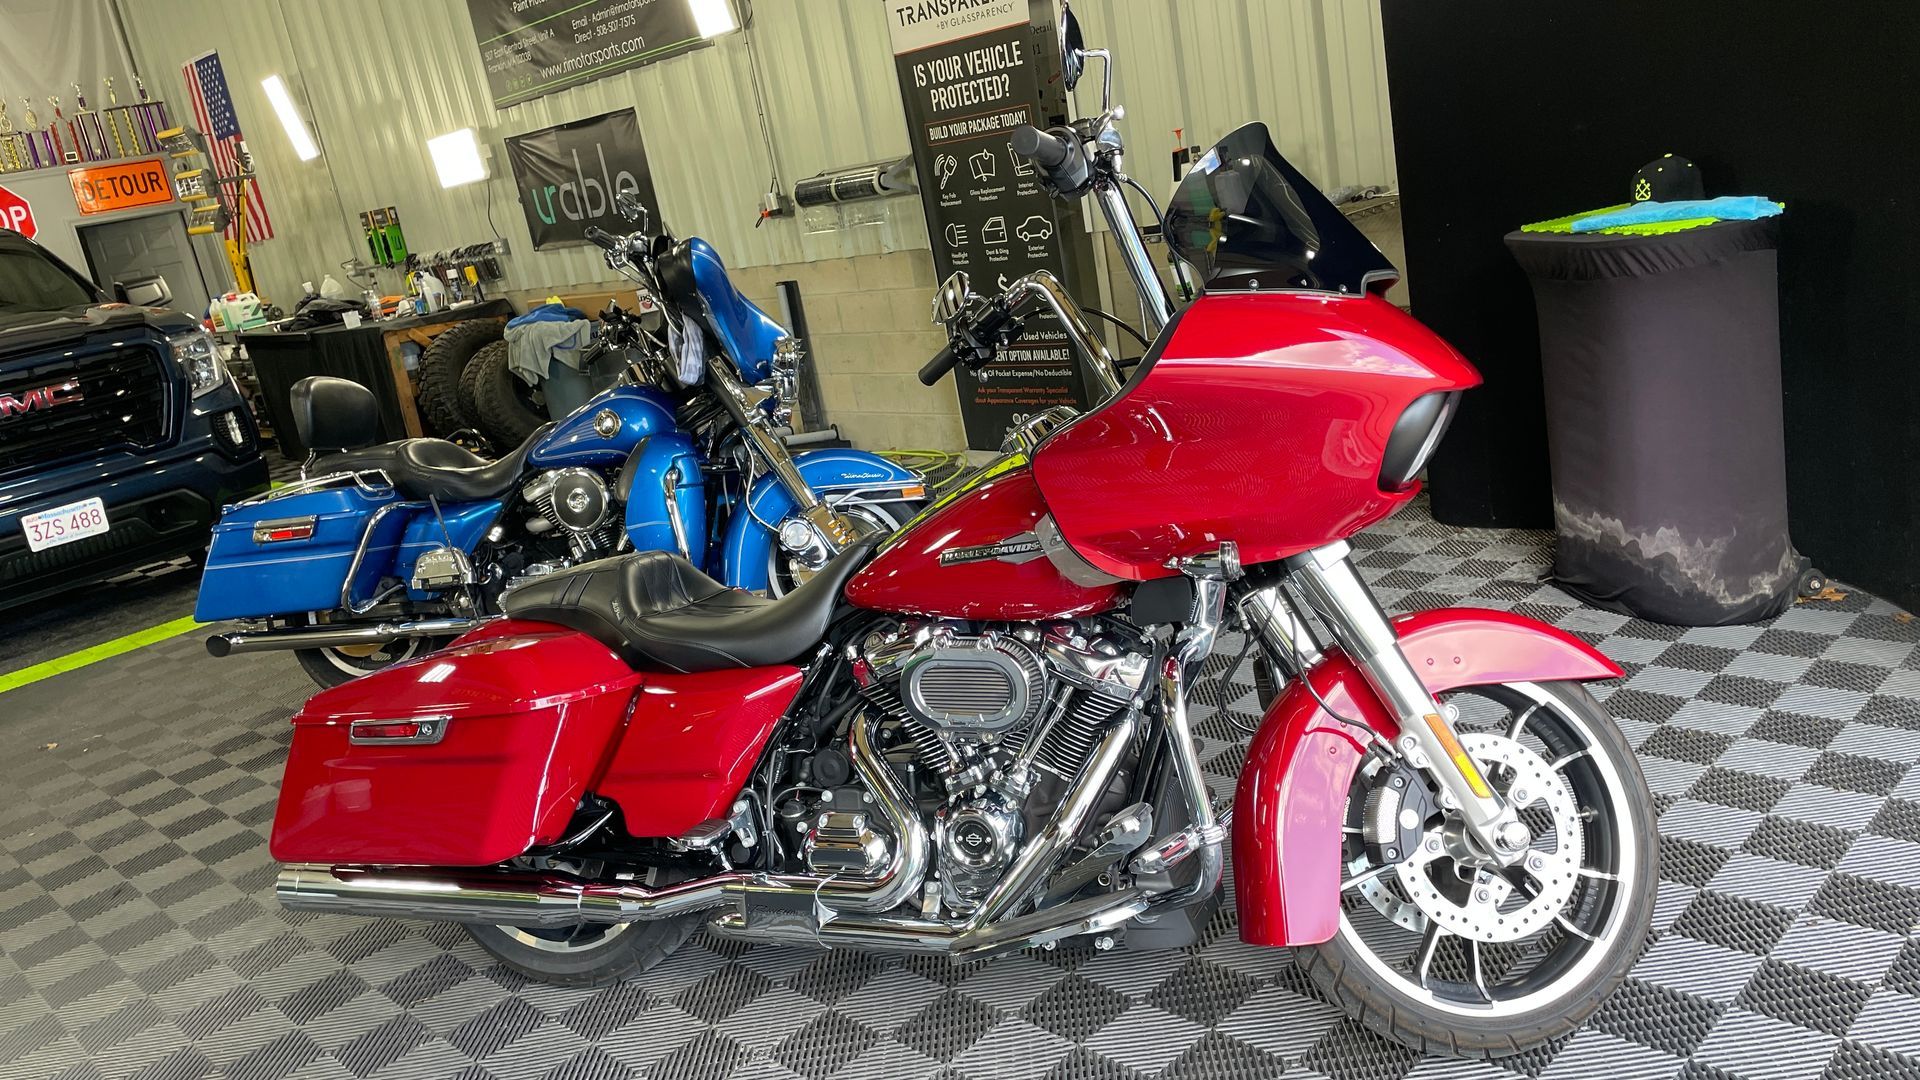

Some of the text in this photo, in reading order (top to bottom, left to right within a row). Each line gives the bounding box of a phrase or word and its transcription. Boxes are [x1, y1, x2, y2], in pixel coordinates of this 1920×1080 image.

[572, 15, 588, 30] Email
[592, 0, 655, 23] Admin@rimotorspo
[896, 0, 996, 27] TRANSPA
[950, 1, 1014, 27] GLASSPARENCY
[549, 28, 555, 38] A
[574, 30, 593, 44] Direct
[596, 14, 636, 37] 508-507-7575
[540, 36, 646, 79] www.rimotorsports.com
[913, 40, 1023, 88] IS YOUR VEHICLE
[930, 74, 1010, 112] PROTECTED?
[929, 110, 1027, 140] BUILD YOUR PACKAGE TODAY!
[80, 172, 163, 201] DETOUR
[1022, 332, 1039, 341] Used
[1040, 330, 1068, 340] Vehicles
[1008, 350, 1032, 361] OPTION
[1032, 348, 1070, 361] AVAILABLE!
[30, 518, 65, 542] 3ZS
[70, 508, 102, 531] 488
